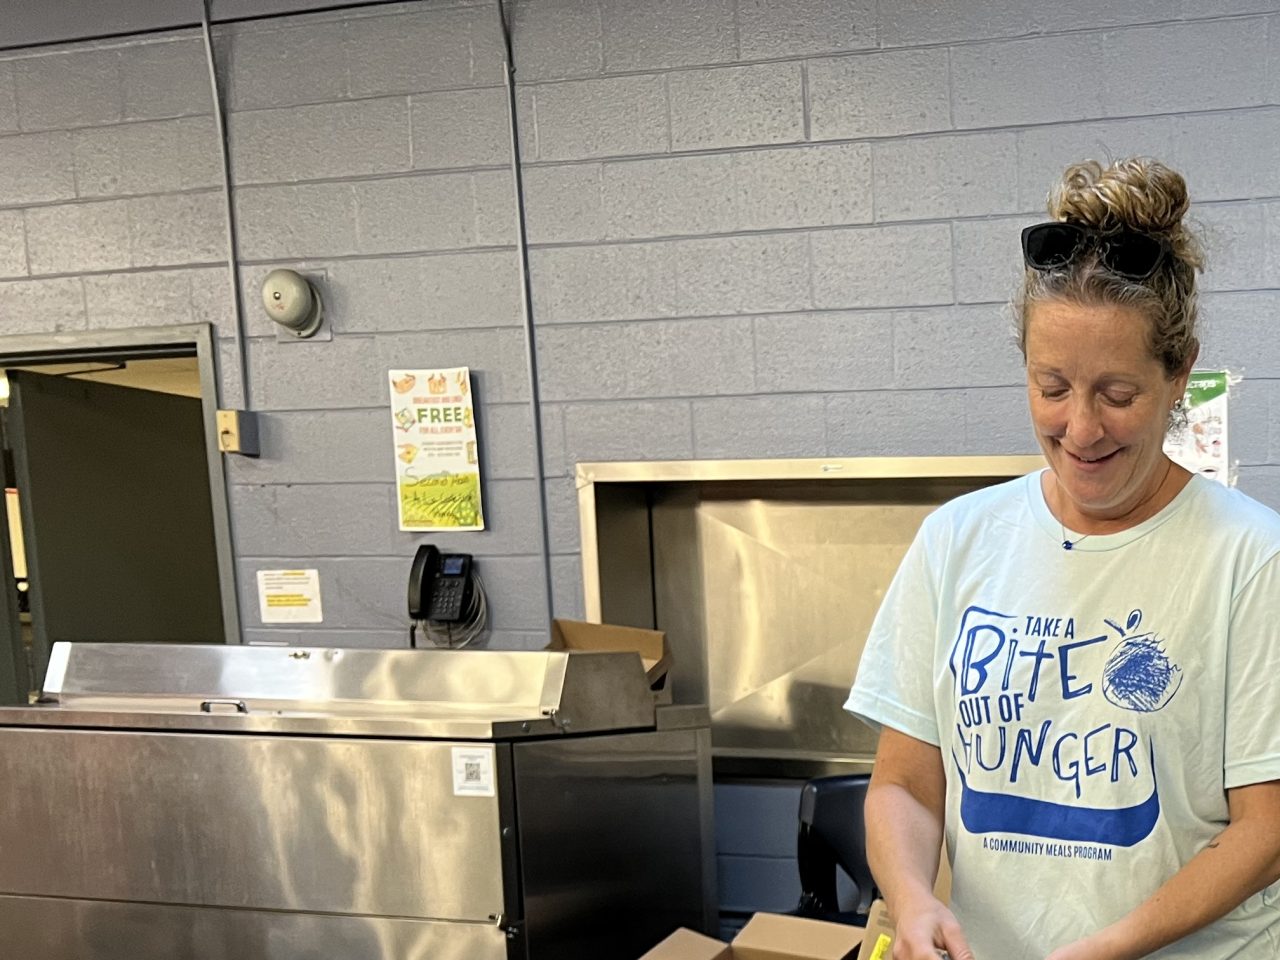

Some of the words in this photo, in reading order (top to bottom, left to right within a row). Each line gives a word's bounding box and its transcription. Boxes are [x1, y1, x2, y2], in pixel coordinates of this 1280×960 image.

[417, 406, 463, 424] FREE
[1025, 616, 1062, 638] TAKE
[1064, 618, 1075, 639] A
[959, 695, 991, 729] OUT
[1000, 693, 1025, 723] OF
[957, 720, 1138, 800] HUNGER
[983, 837, 989, 849] A
[989, 839, 1044, 856] COMMUNITY
[1046, 845, 1073, 858] MEALS
[1073, 847, 1113, 861] PROGRAM
